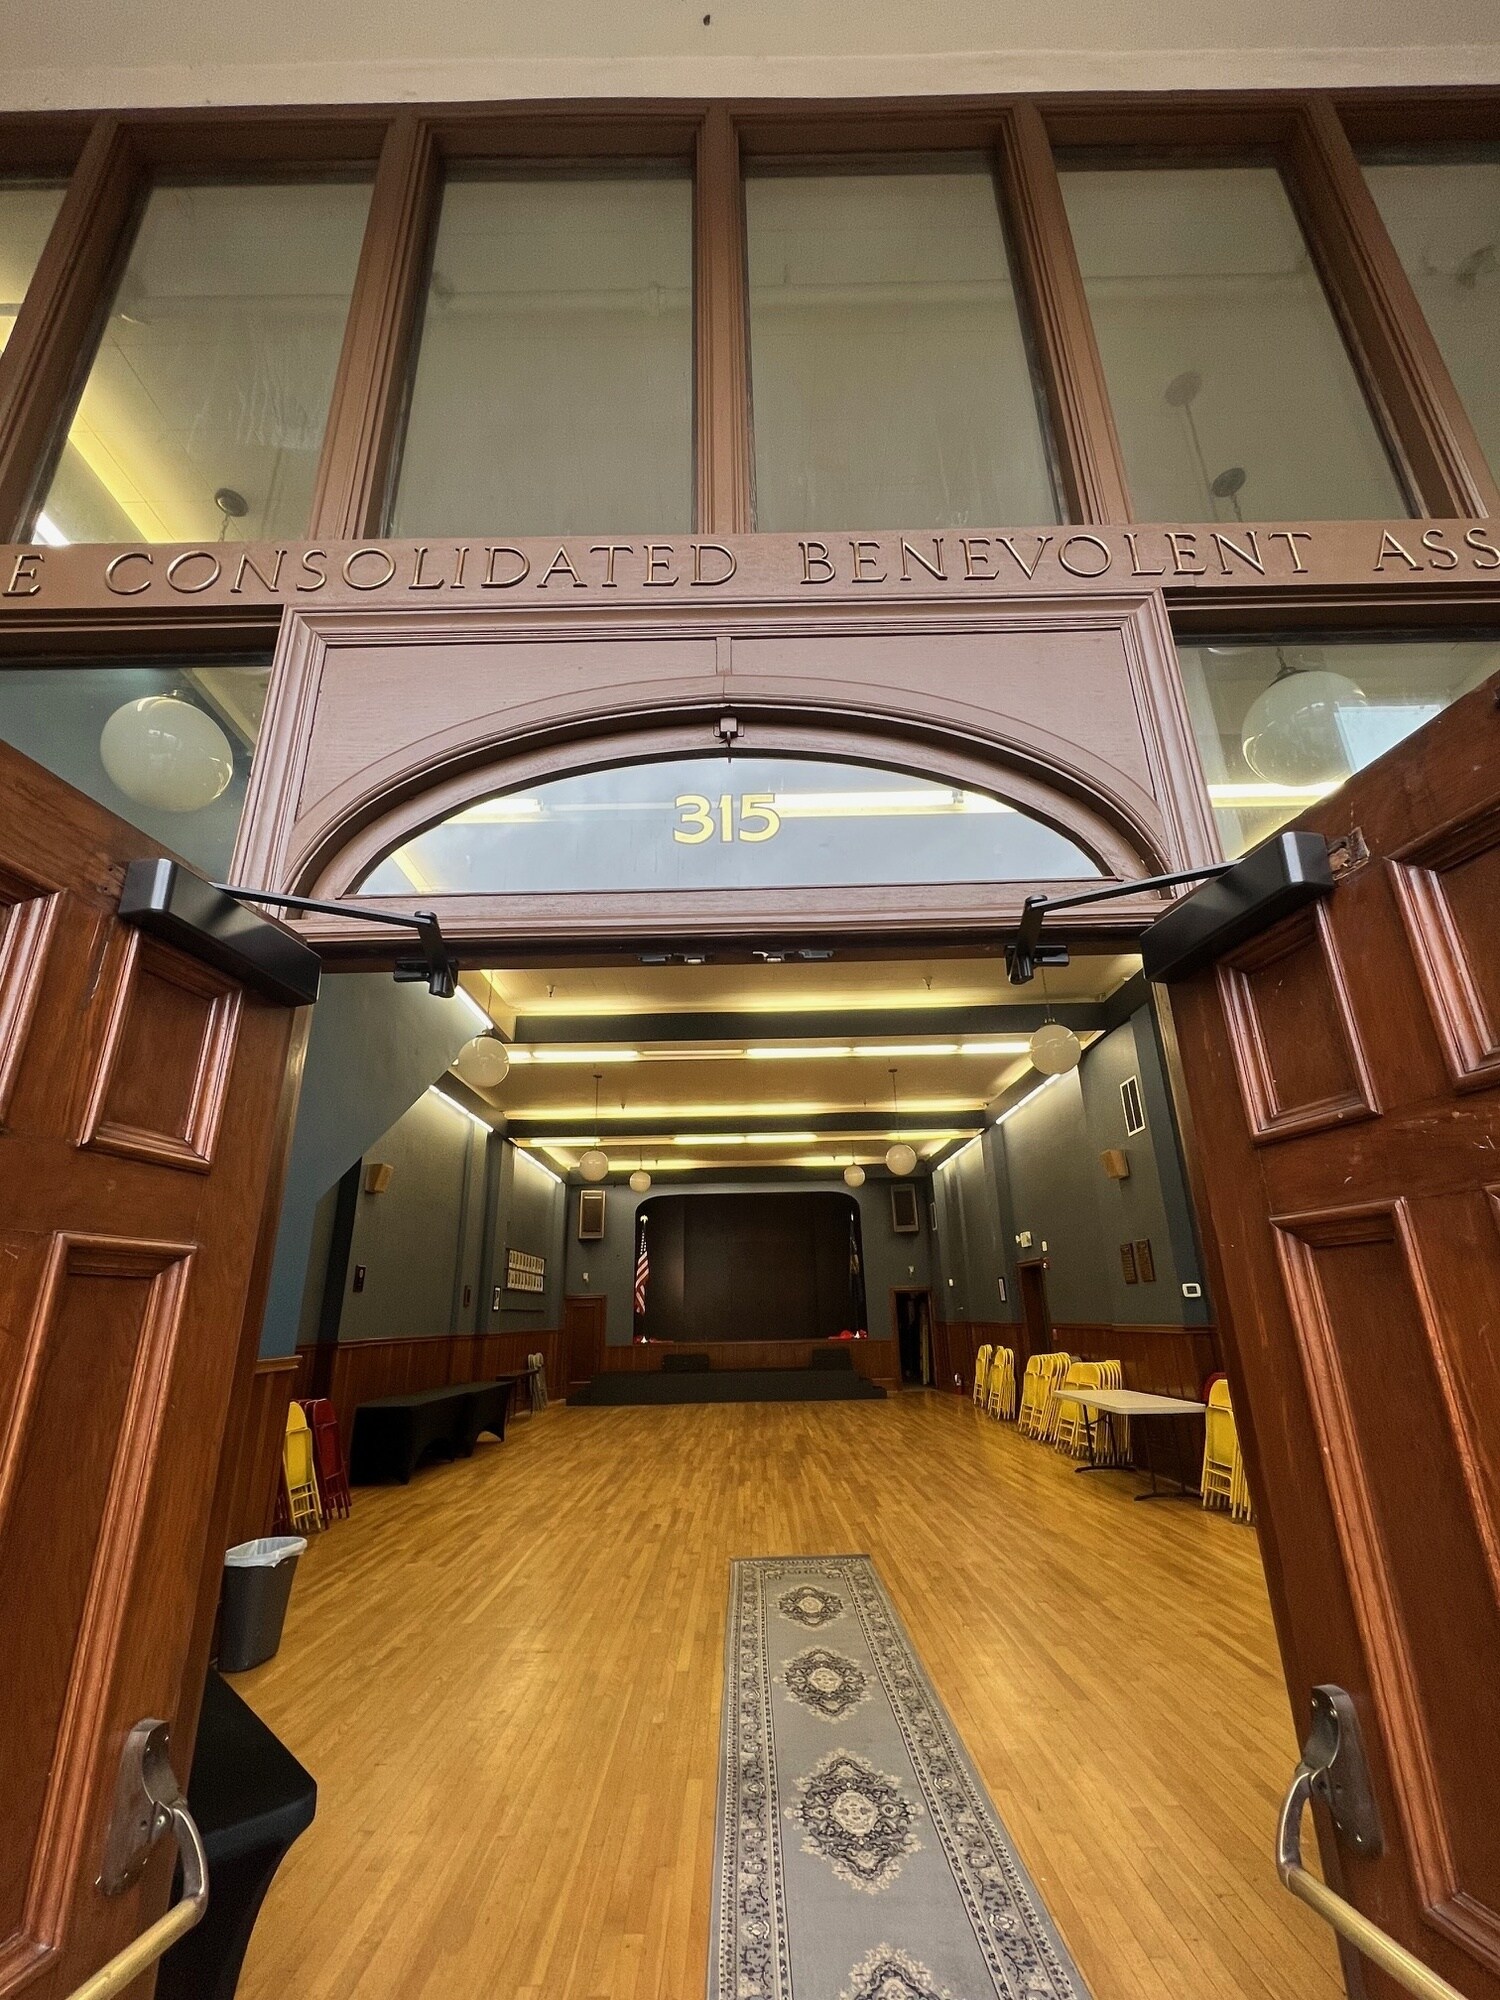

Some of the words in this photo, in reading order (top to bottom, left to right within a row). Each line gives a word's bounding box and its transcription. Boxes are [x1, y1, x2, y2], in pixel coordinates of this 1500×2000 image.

[2, 553, 46, 597] E
[104, 543, 738, 595] CONSOLIDATED
[798, 531, 1312, 585] BENEVOLENT
[1372, 527, 1500, 571] ASS
[672, 793, 782, 844] 315
